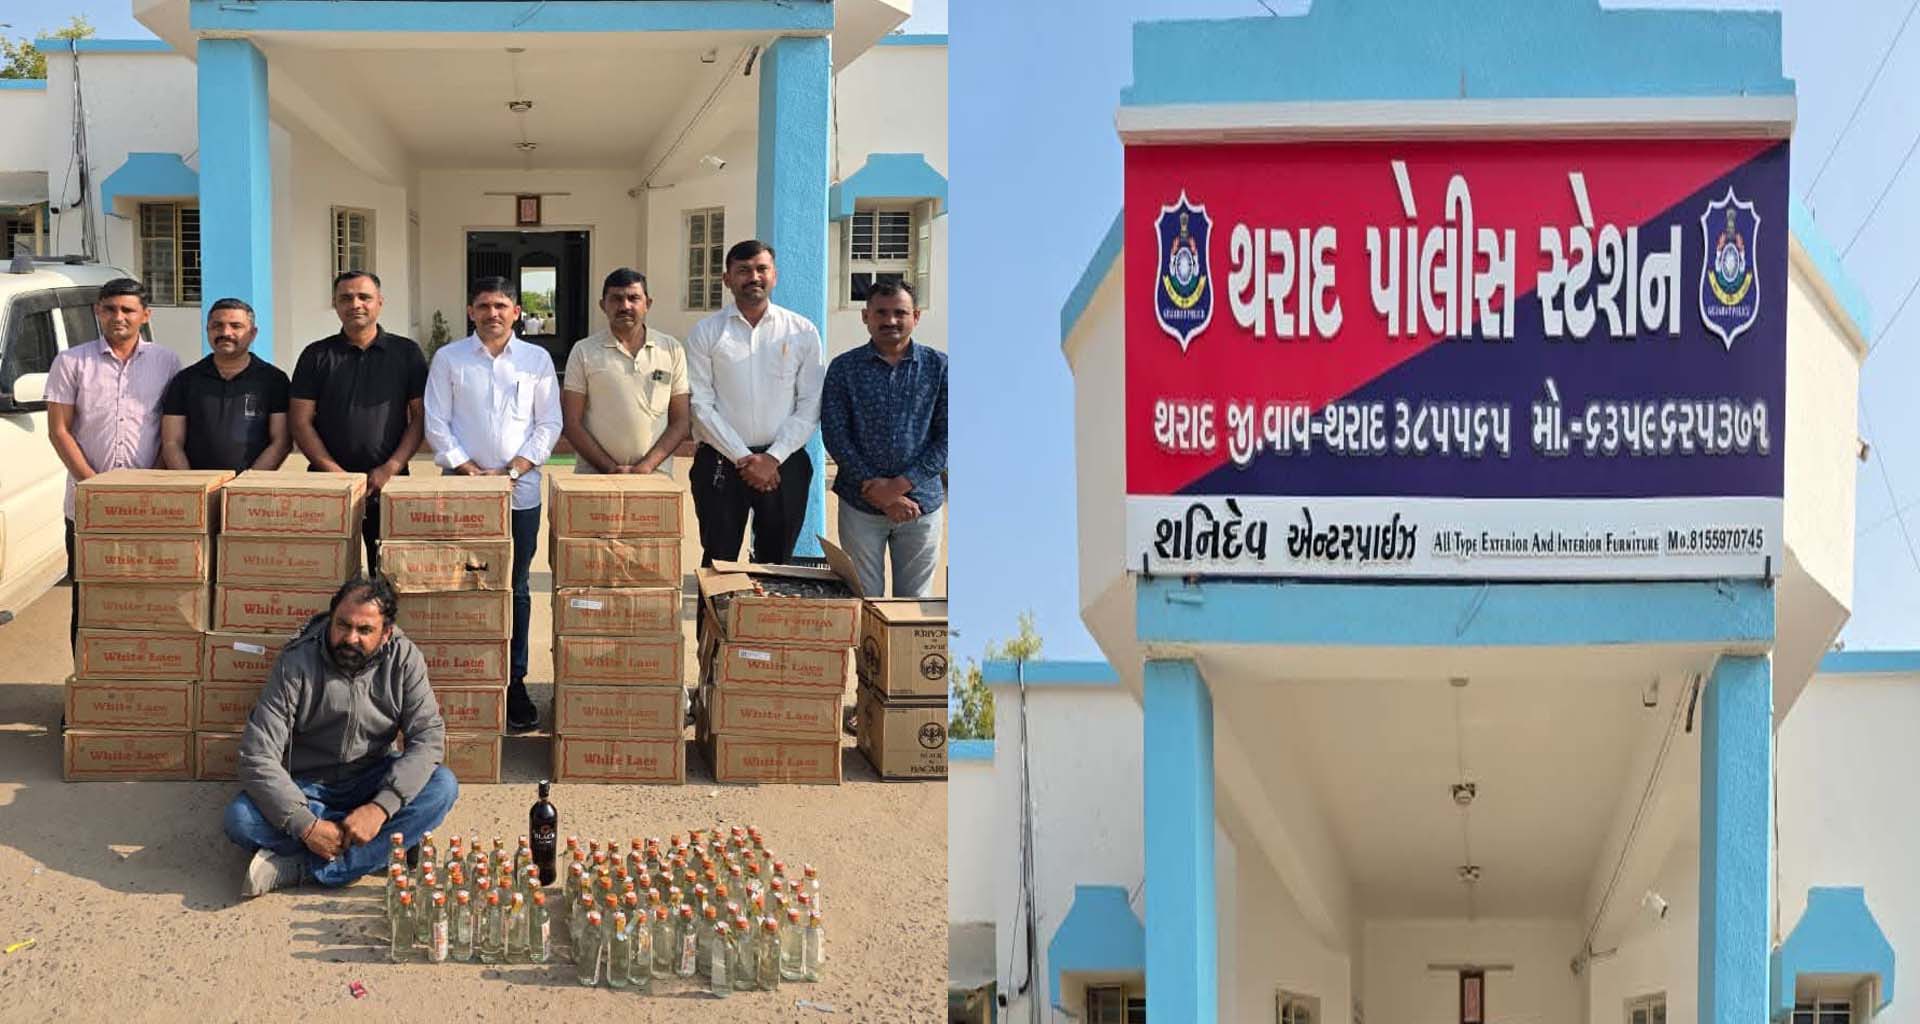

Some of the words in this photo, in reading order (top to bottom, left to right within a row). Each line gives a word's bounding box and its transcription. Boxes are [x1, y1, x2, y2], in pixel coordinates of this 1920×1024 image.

[1227, 223, 1344, 338] થરાદ
[1366, 159, 1516, 338] પોલીસ
[1537, 171, 1683, 338] સ્ટેશન
[1154, 400, 1216, 450] થરાદ
[1394, 401, 1510, 453] ૩૮૫૫૬૫
[411, 512, 449, 523] White
[454, 513, 485, 523] Lace
[1154, 498, 1268, 560] શનિદેવ
[1434, 531, 1450, 551] All
[1668, 529, 1763, 550] Mo.8155970745
[244, 603, 283, 615] White
[453, 657, 485, 669] Lace
[584, 754, 622, 765] White
[627, 755, 658, 766] Lace
